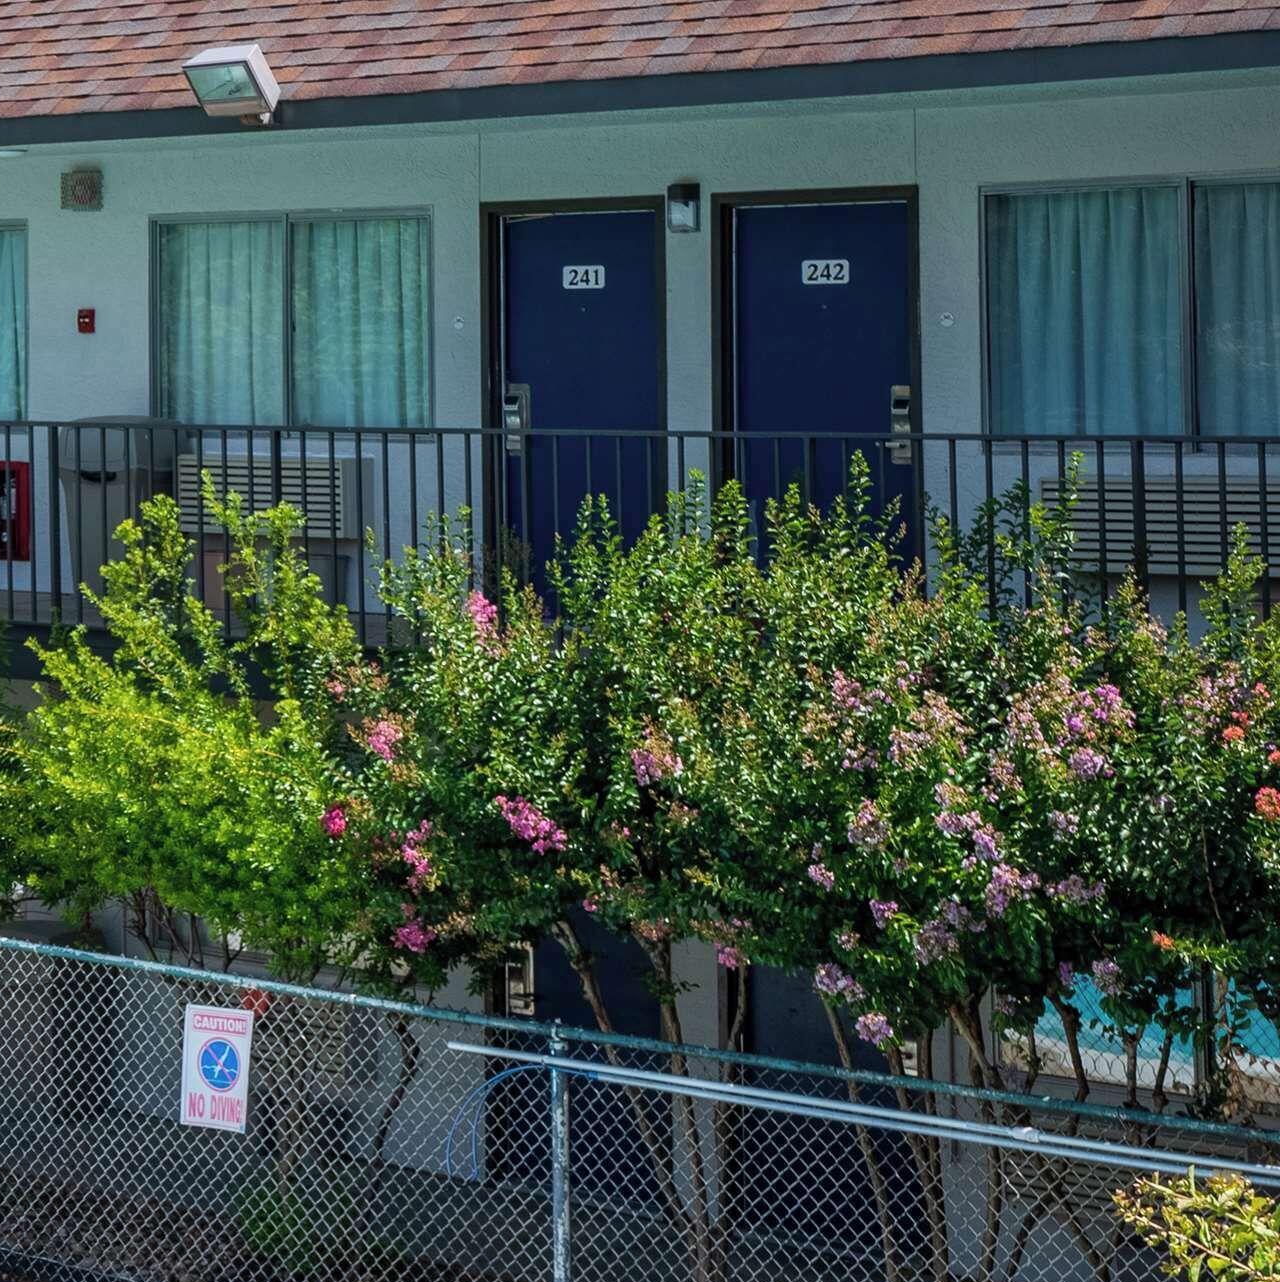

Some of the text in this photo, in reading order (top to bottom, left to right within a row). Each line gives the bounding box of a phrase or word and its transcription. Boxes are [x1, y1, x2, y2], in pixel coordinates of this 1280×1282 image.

[568, 269, 600, 286] 241
[806, 263, 846, 282] 242
[194, 1015, 246, 1034] CAUTION!
[188, 1091, 205, 1117] NO
